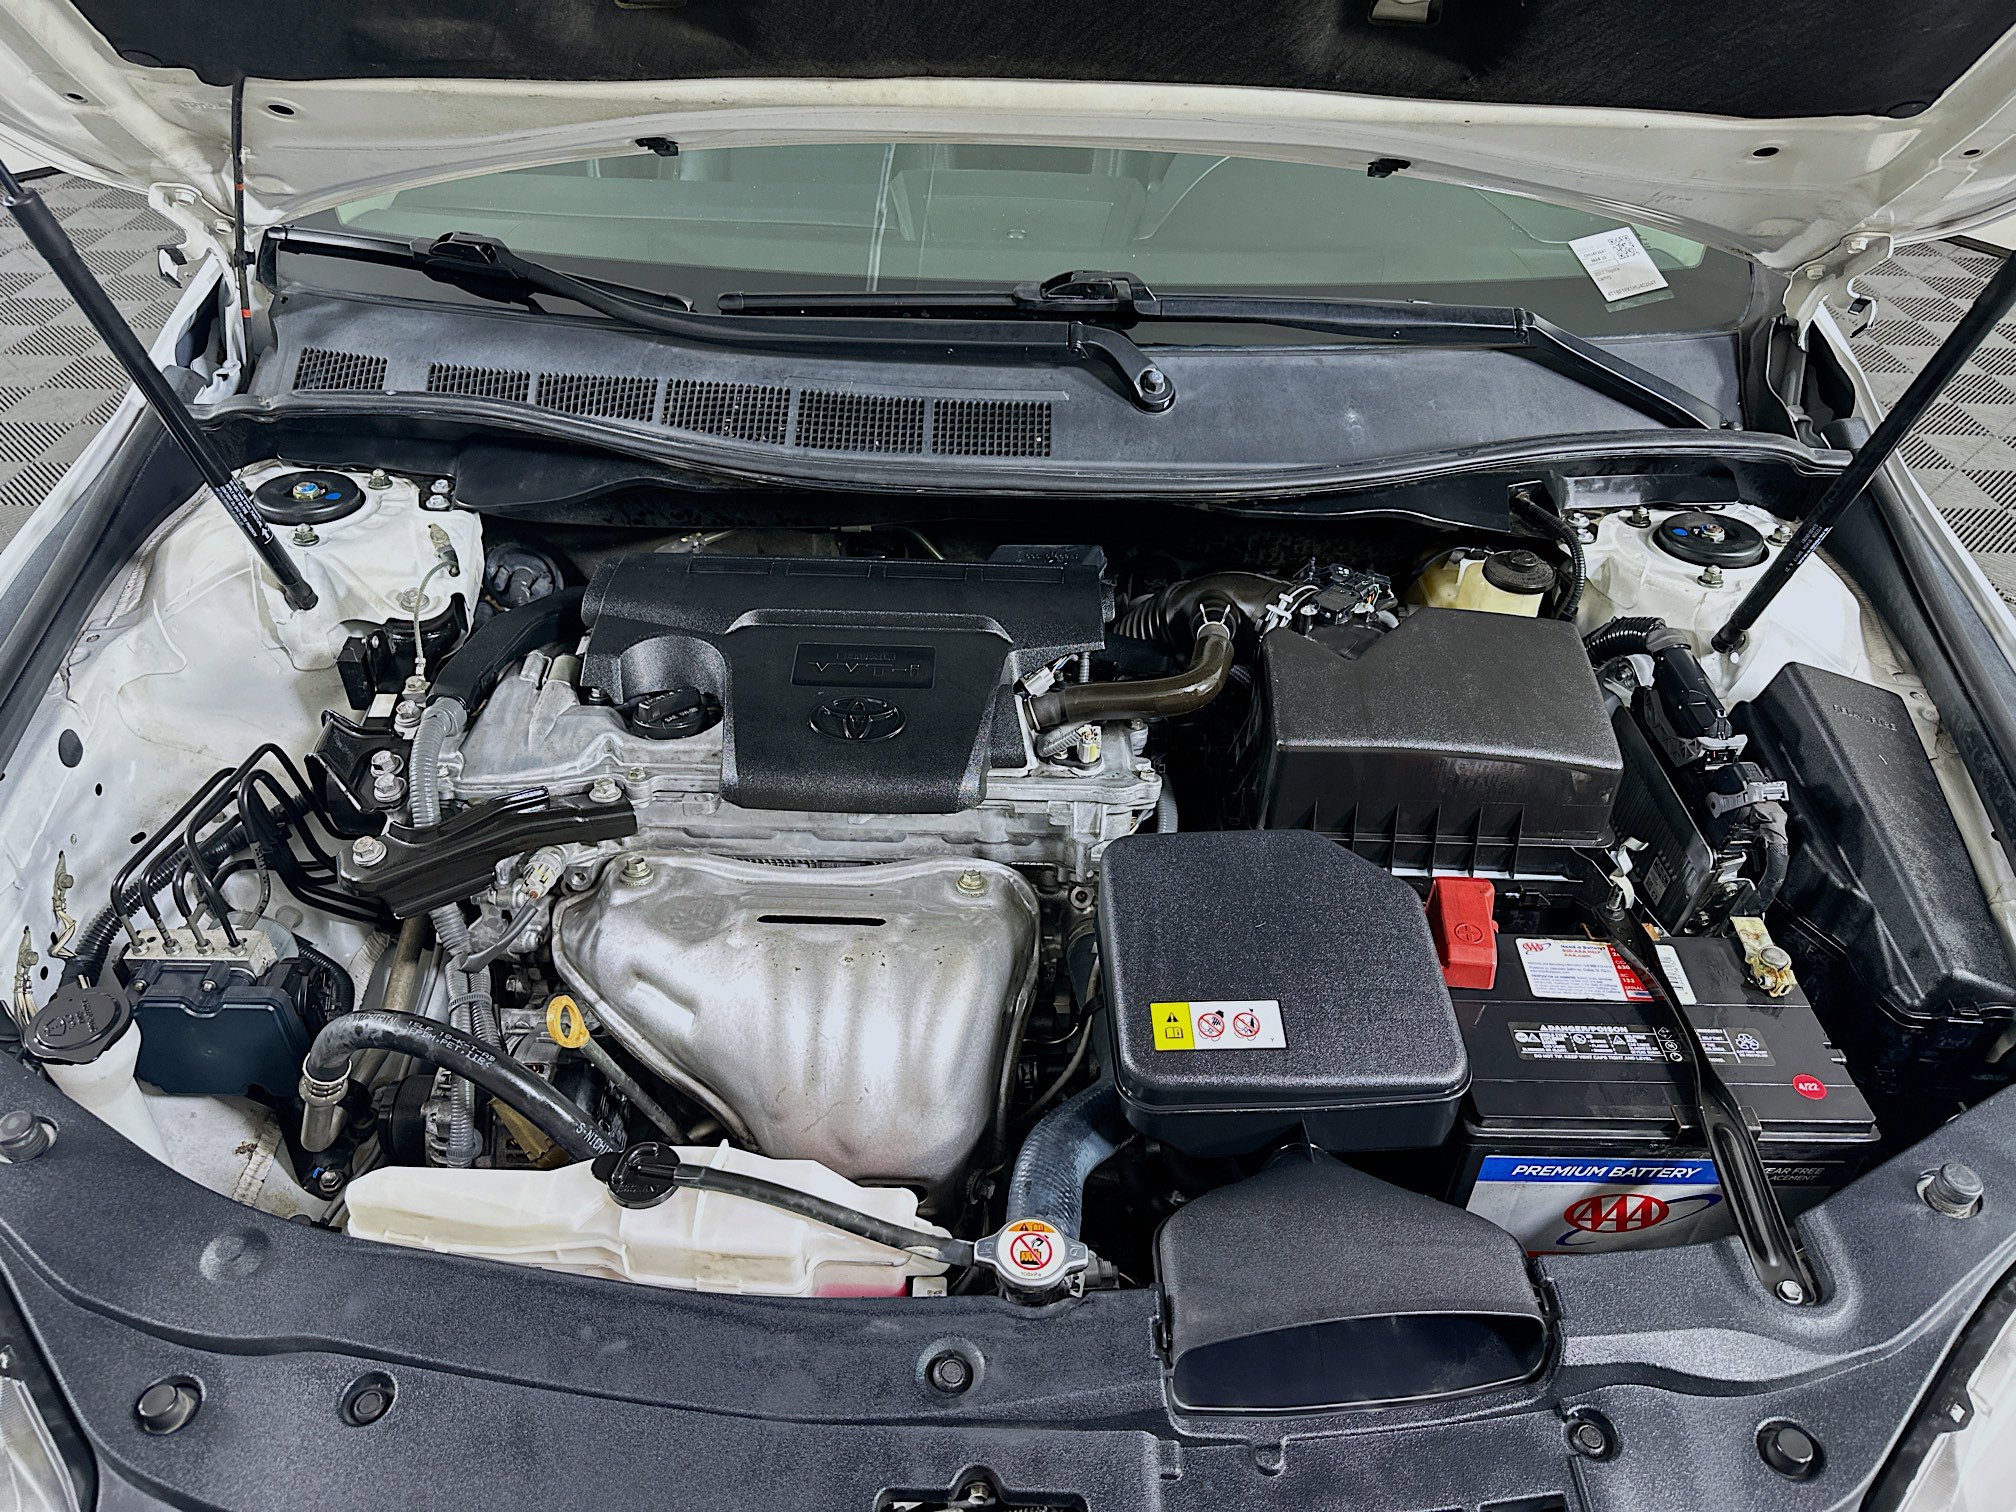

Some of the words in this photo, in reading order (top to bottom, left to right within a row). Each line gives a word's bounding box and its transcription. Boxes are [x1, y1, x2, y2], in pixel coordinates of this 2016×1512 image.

[1547, 1025, 1628, 1033] DANGER/POISON
[1799, 1083, 1819, 1091] 4/22
[1511, 1165, 1608, 1177] PREMIUM
[1609, 1167, 1702, 1179] BATTERY
[1574, 1194, 1660, 1232] AAA
